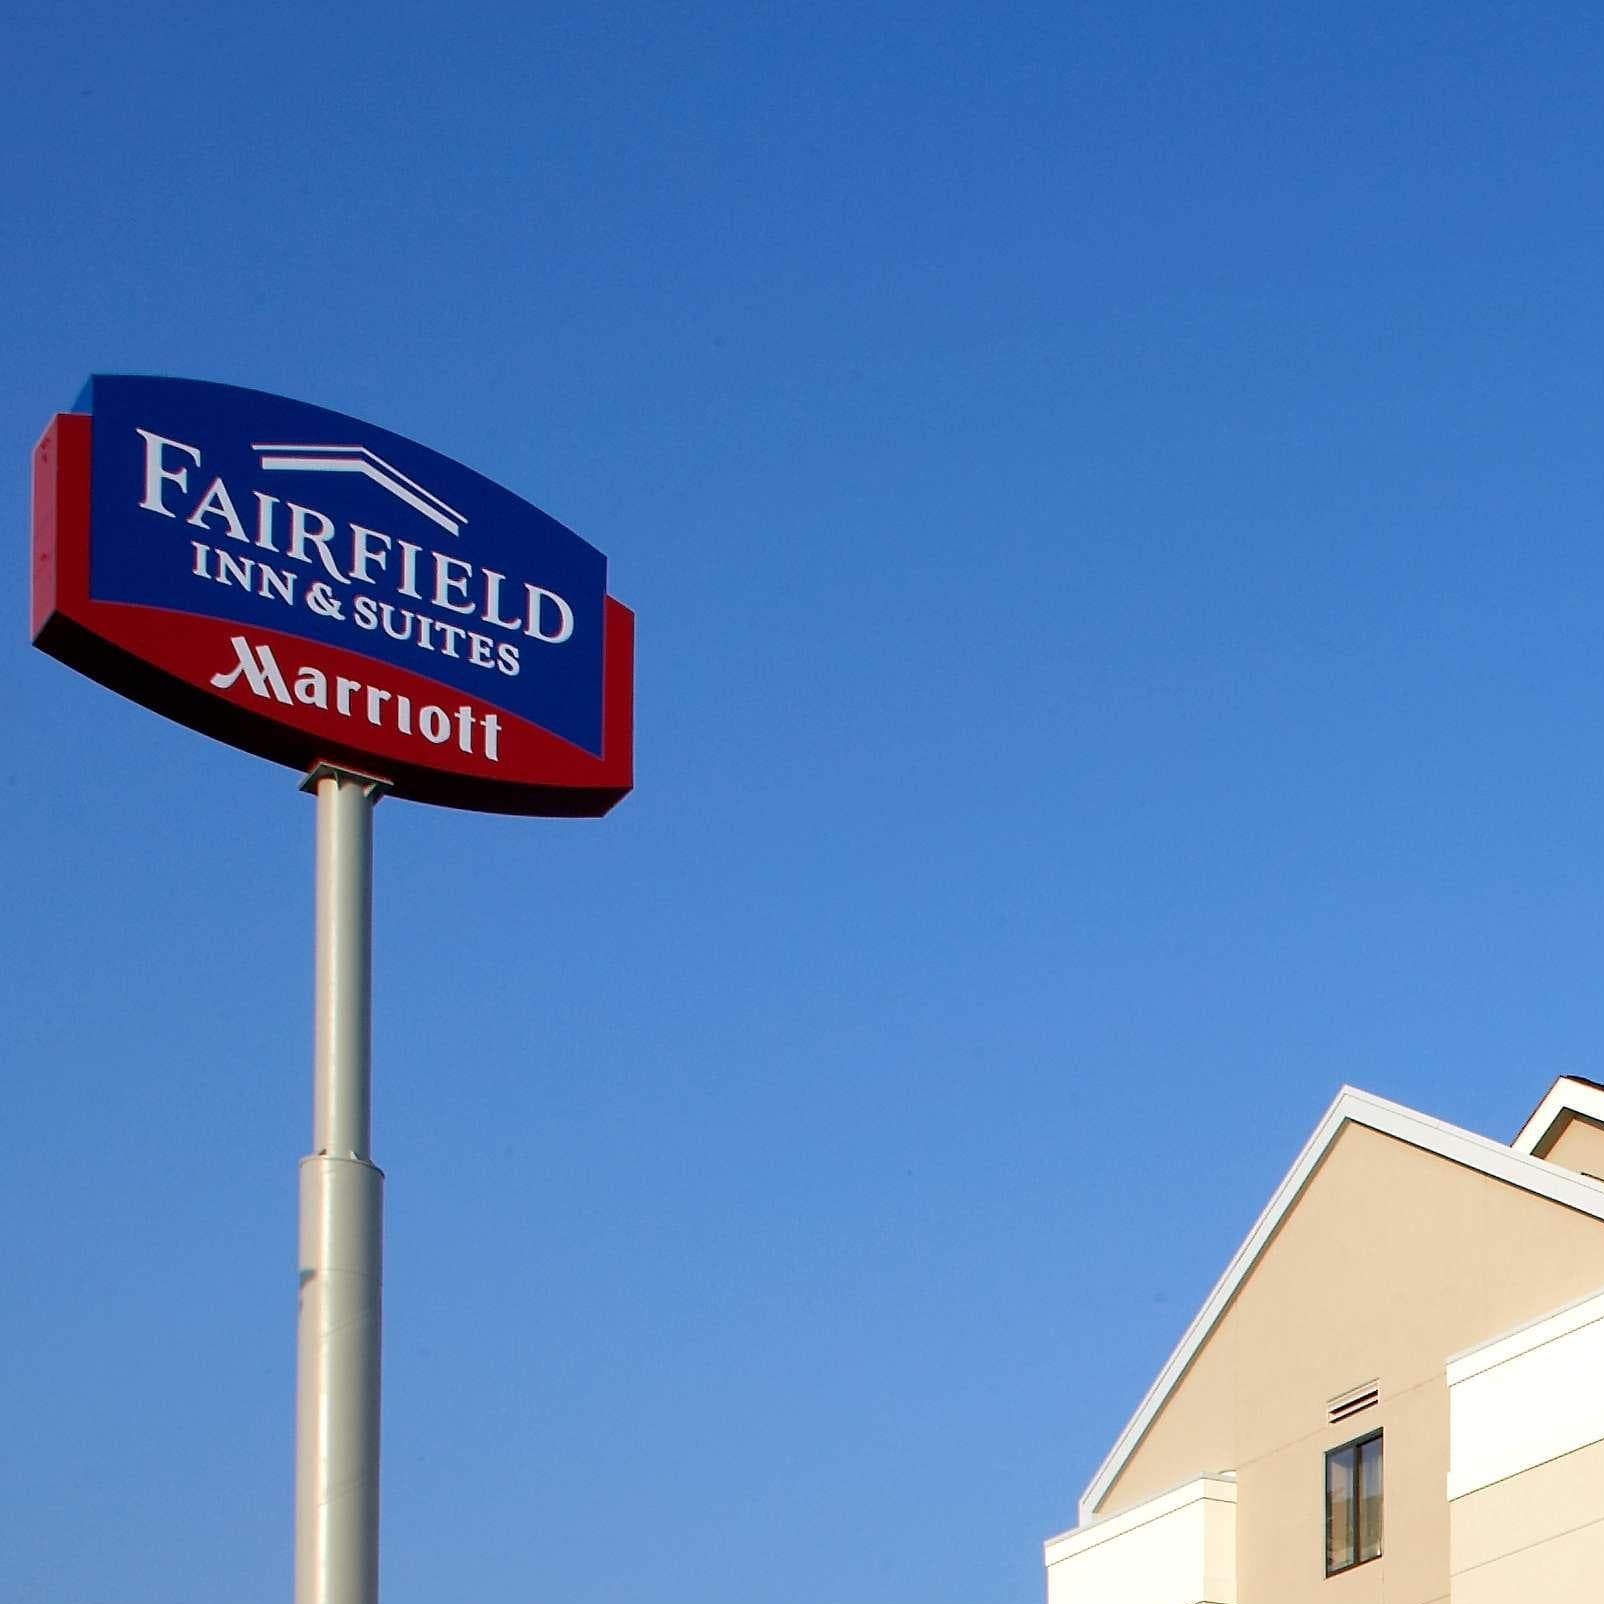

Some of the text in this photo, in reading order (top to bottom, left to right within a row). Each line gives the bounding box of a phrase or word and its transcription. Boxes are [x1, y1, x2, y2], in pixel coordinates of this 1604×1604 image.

[136, 428, 574, 643] FAIRFIELD
[191, 541, 520, 676] INN & SUITES
[210, 636, 502, 762] Marriott
